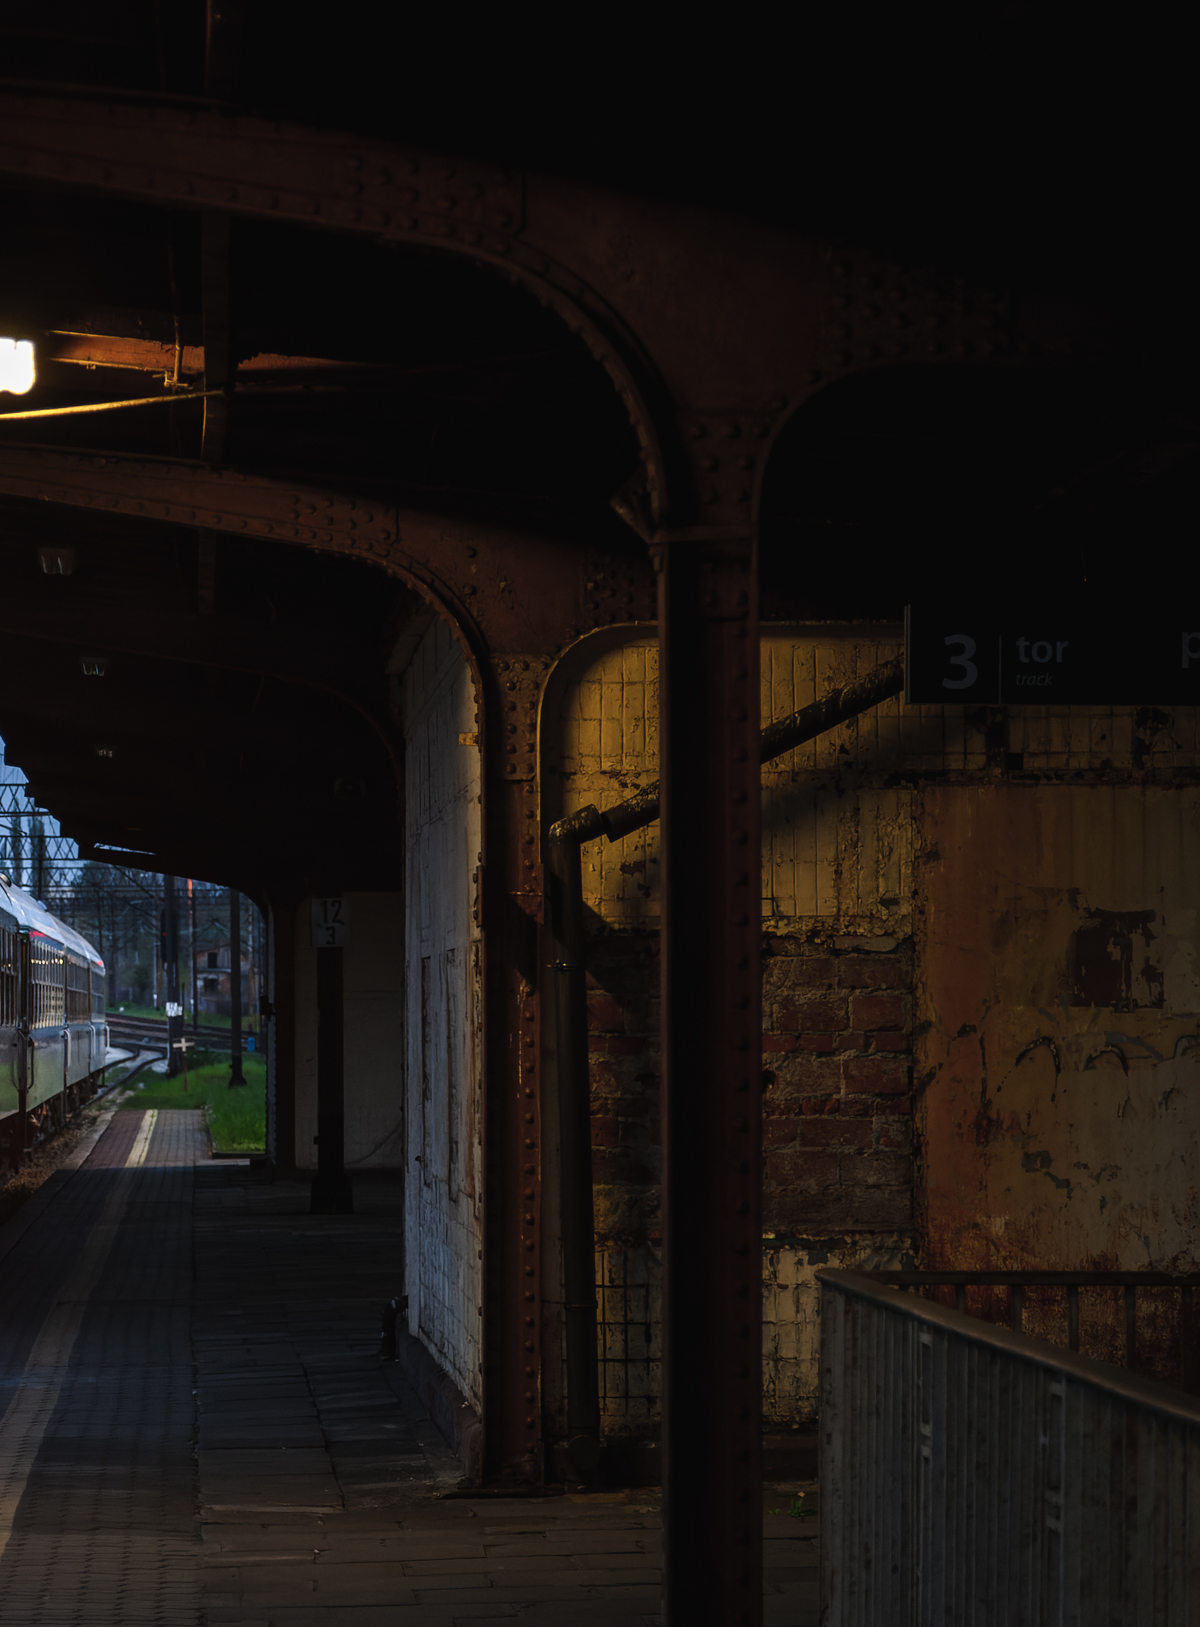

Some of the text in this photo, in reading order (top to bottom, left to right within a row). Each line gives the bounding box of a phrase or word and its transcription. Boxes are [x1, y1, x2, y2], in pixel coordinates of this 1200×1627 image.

[942, 633, 978, 690] 3
[1016, 636, 1070, 663] tor
[1016, 671, 1054, 686] track
[320, 900, 345, 926] 12
[325, 926, 336, 945] 3
